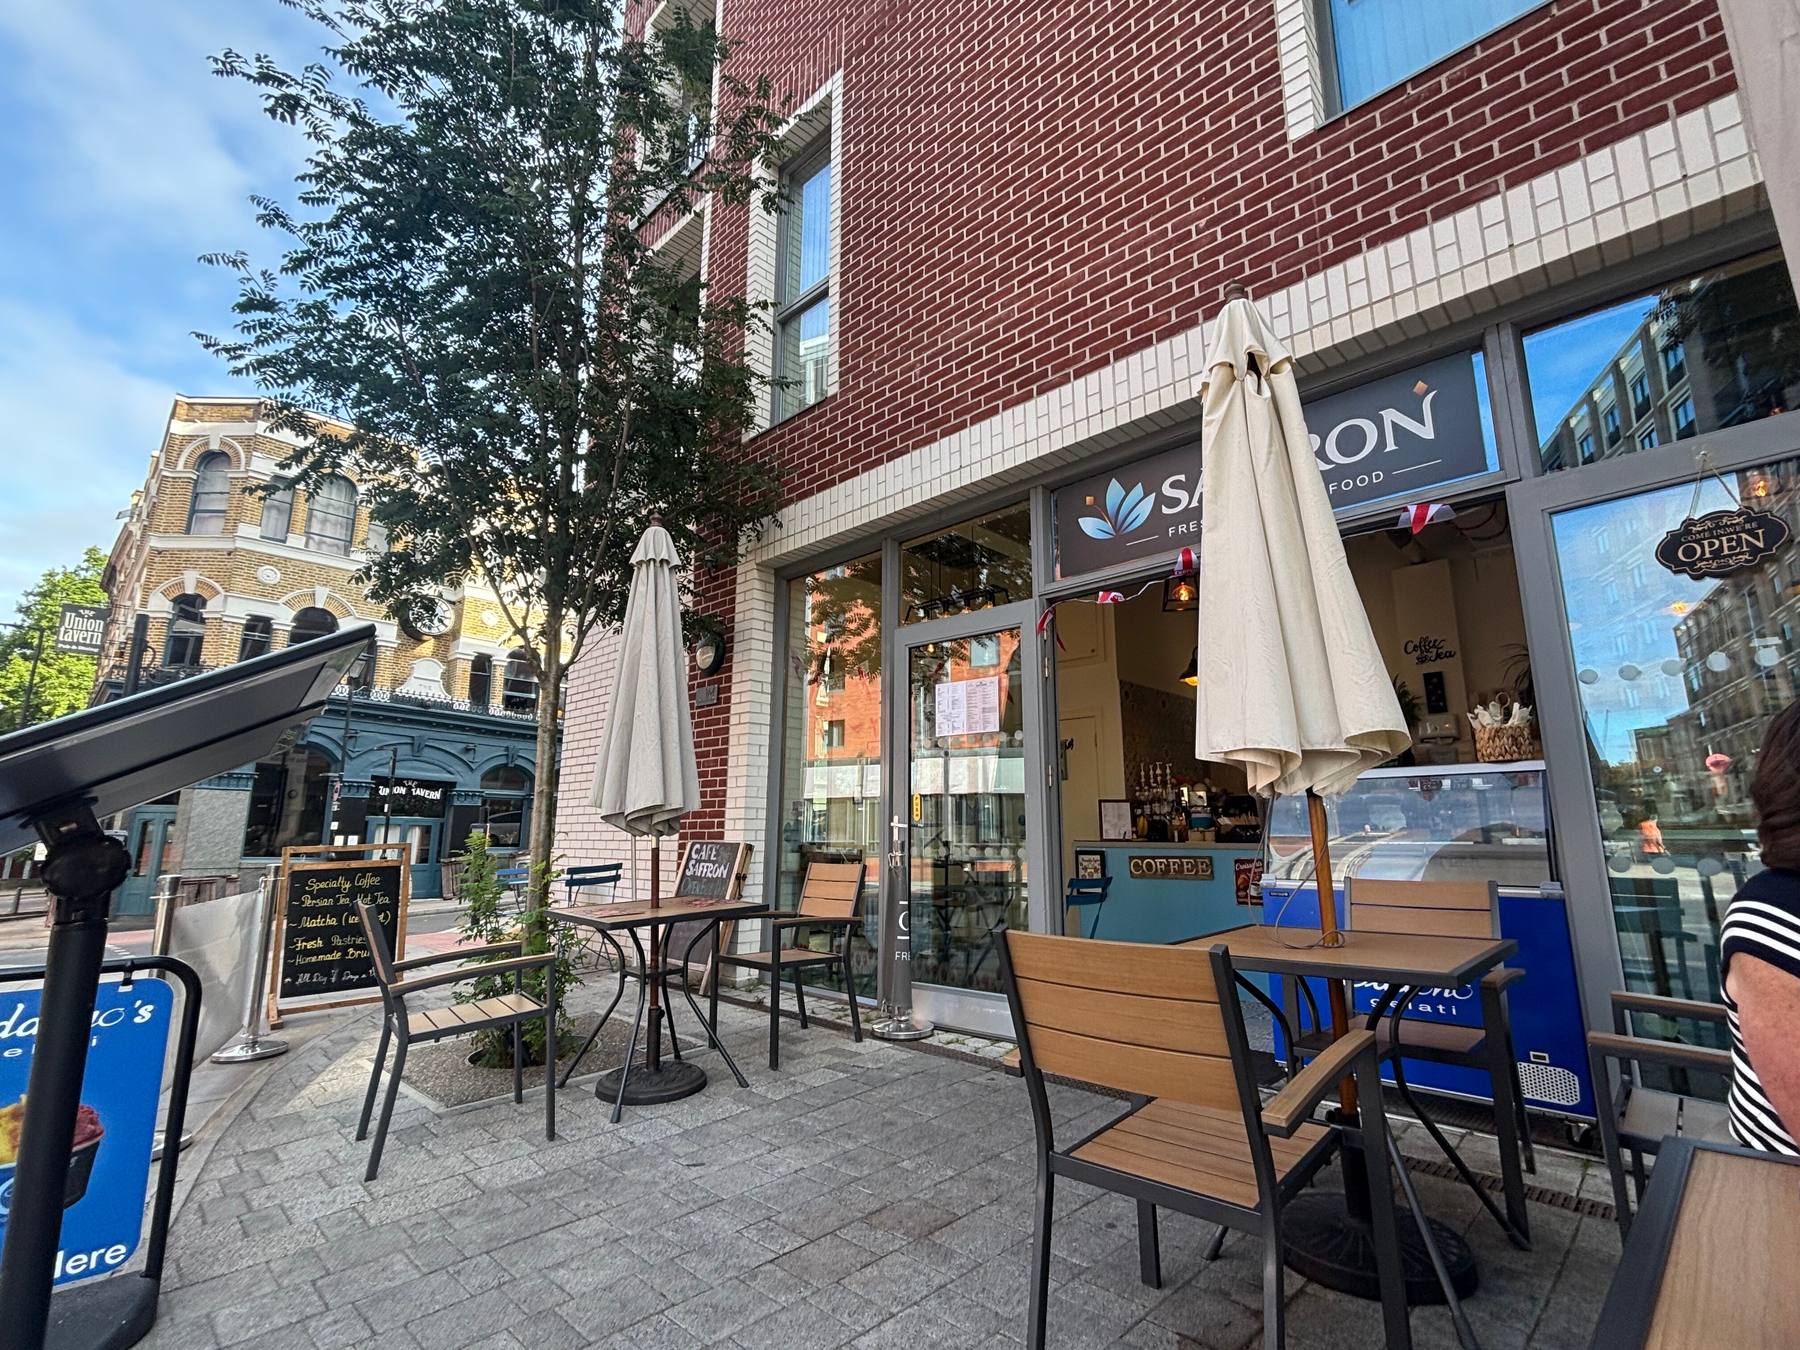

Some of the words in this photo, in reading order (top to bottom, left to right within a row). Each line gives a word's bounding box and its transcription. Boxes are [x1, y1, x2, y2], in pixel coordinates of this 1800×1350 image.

[1328, 471, 1384, 495] FOOD
[1677, 528, 1765, 562] OPEN
[1681, 530, 1712, 543] COME
[64, 612, 104, 632] Union
[1403, 636, 1446, 655] Coffee
[402, 780, 418, 788] THE
[411, 787, 443, 800] TAVERN
[685, 860, 730, 879] SAFFRON
[1130, 858, 1213, 876] COFFEE
[305, 875, 352, 894] Specialty
[354, 872, 381, 889] Coffee
[301, 894, 334, 907] Persian
[373, 891, 391, 905] Tea
[298, 914, 338, 928] Matcha
[294, 936, 324, 951] Fresh
[295, 951, 342, 966] Homemade
